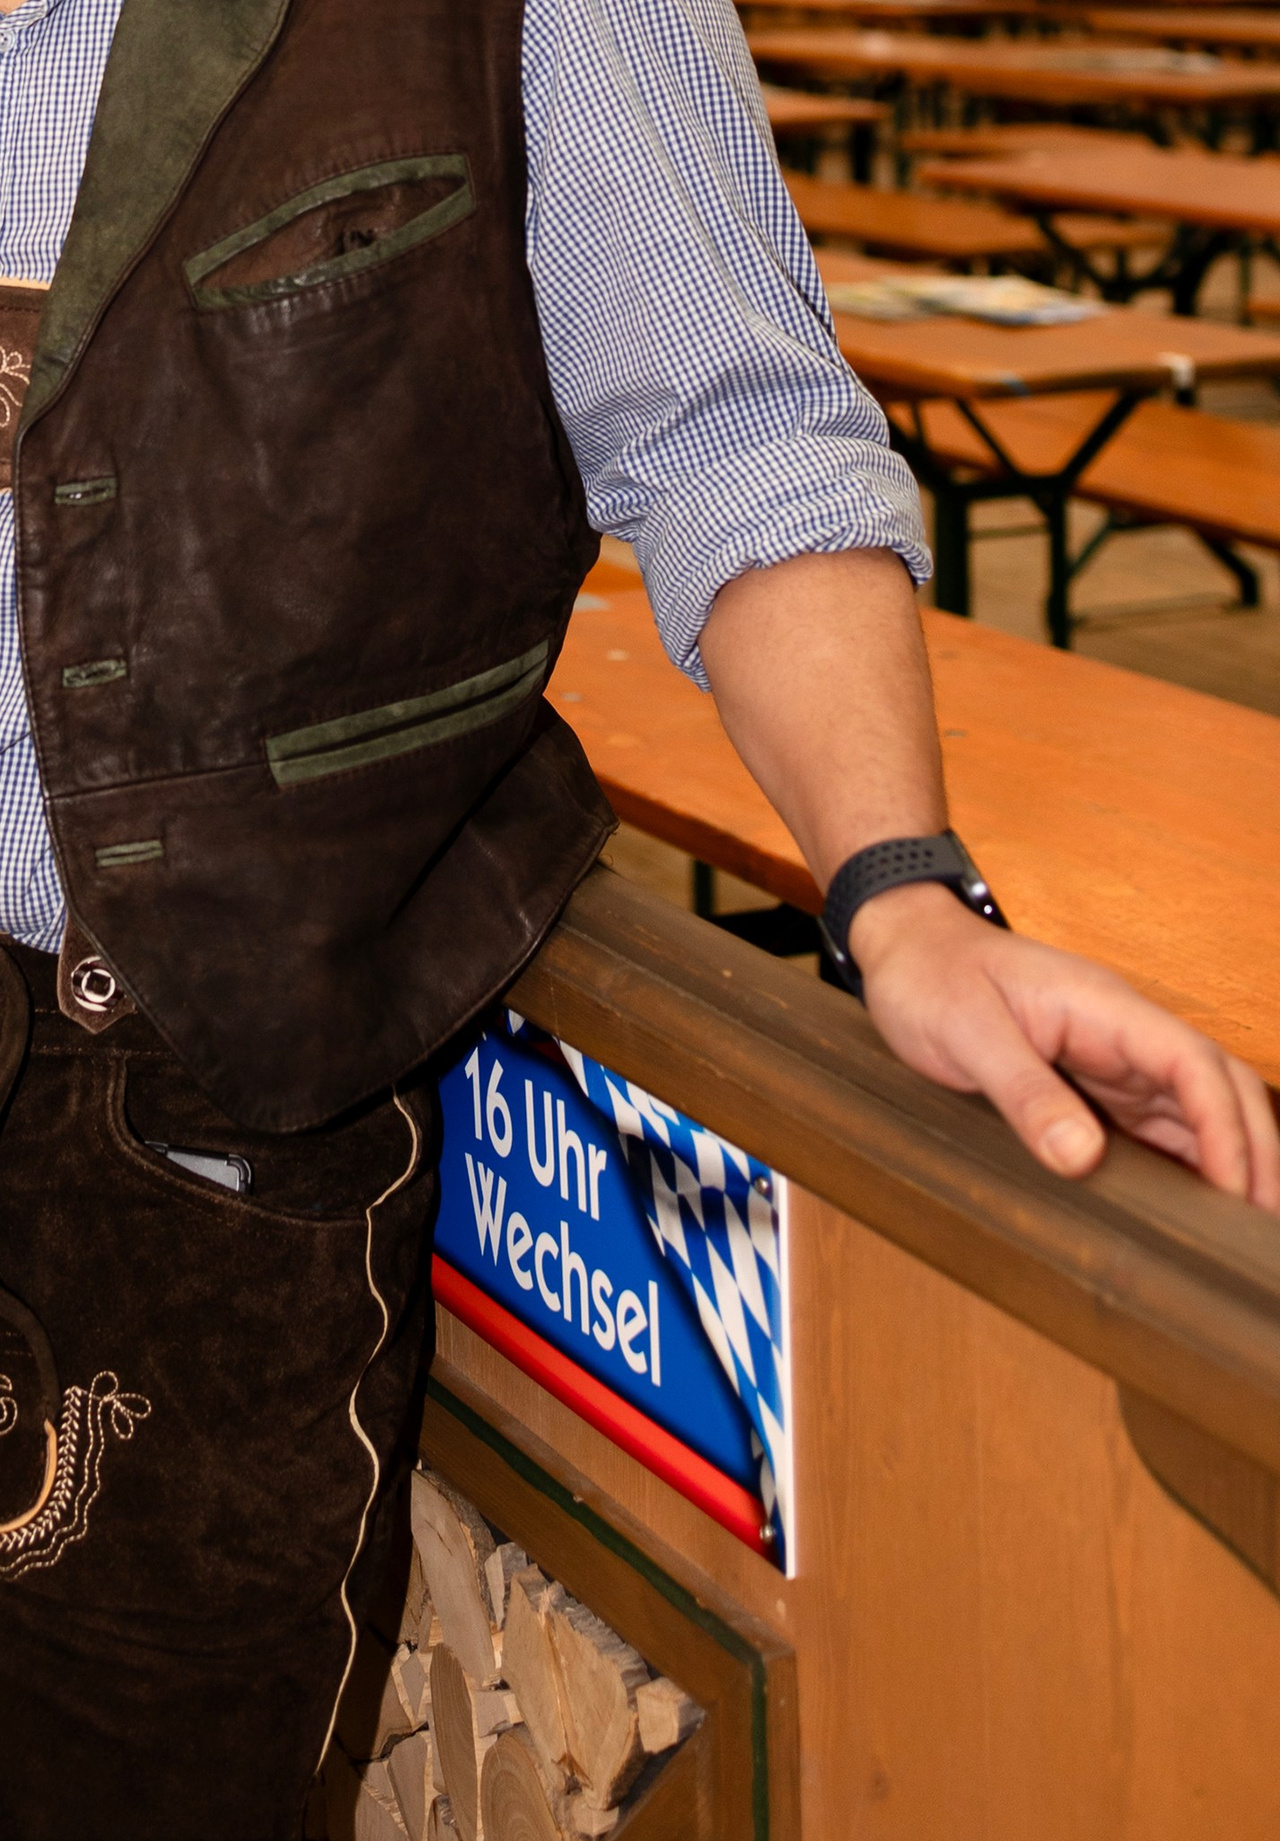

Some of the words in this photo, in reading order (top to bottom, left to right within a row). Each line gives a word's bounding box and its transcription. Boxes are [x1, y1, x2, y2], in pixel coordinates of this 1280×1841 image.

[464, 1046, 514, 1158] 16
[524, 1079, 608, 1221] Uhr
[464, 1152, 662, 1387] Wechsel
